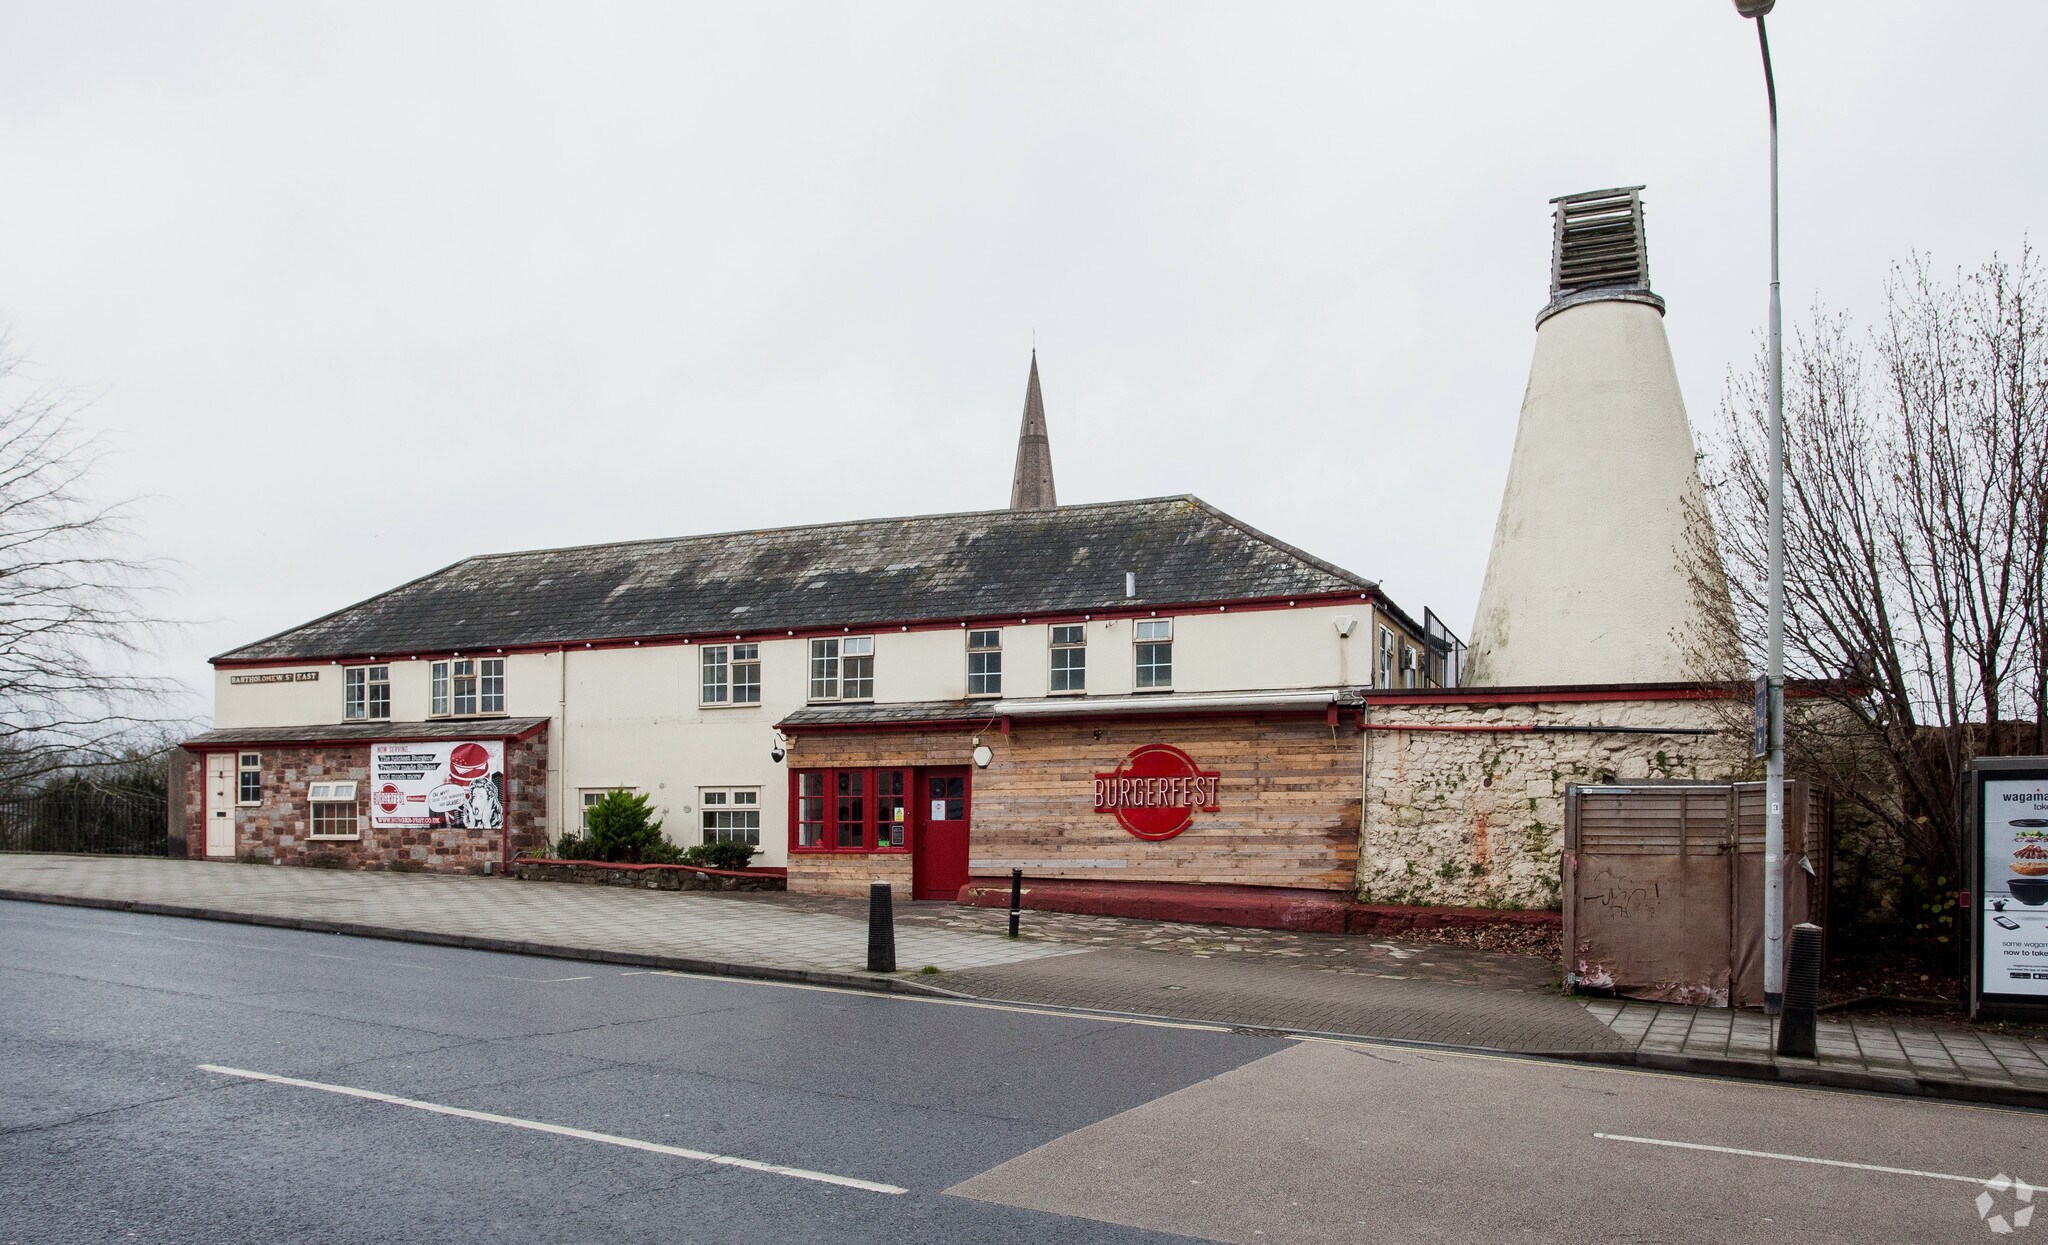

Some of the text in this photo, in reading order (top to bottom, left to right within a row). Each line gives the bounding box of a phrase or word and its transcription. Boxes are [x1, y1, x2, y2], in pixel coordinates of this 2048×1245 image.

[231, 674, 283, 684] BARTHOLOMEW
[296, 672, 316, 681] EAST
[1094, 777, 1219, 807] BURGERFEST
